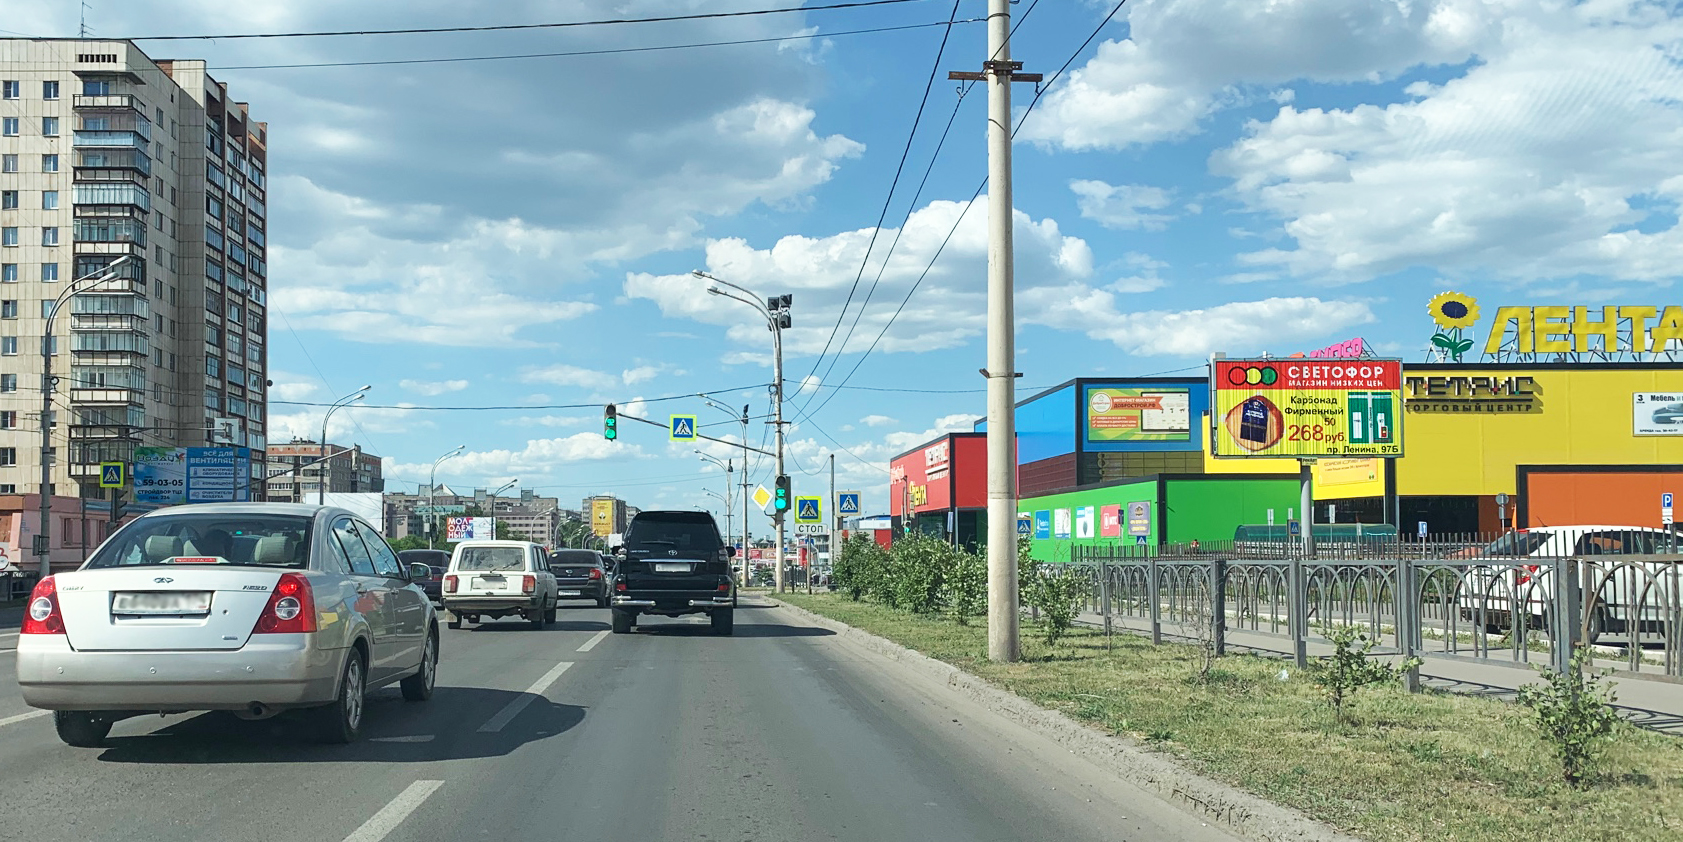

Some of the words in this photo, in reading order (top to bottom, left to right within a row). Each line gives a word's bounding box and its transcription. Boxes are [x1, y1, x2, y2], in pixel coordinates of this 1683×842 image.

[1485, 305, 1683, 354] ЛЕНТА
[1288, 365, 1384, 379] СВЕТОФОР
[1288, 379, 1328, 387] МАГАЗИН
[1330, 379, 1364, 387] НИЗКИХ
[1366, 379, 1383, 387] ЦЕН
[1404, 376, 1534, 396] ТЕТРИС
[1290, 395, 1338, 405] Карбонад
[1637, 394, 1644, 402] 3
[1650, 394, 1676, 402] Мебель
[1284, 406, 1344, 416] Фирменный
[1405, 402, 1481, 412] ТОРГОВЫЙ
[1487, 404, 1533, 413] ЦЕНТР
[1324, 417, 1336, 426] 50
[1288, 424, 1324, 442] 268
[1325, 432, 1347, 444] руб.
[1326, 446, 1340, 455] пр.
[1381, 445, 1399, 453] 97Б
[142, 479, 184, 487] 59-03-05
[448, 524, 473, 532] ОДЕЖ
[798, 524, 824, 534] СТОП
